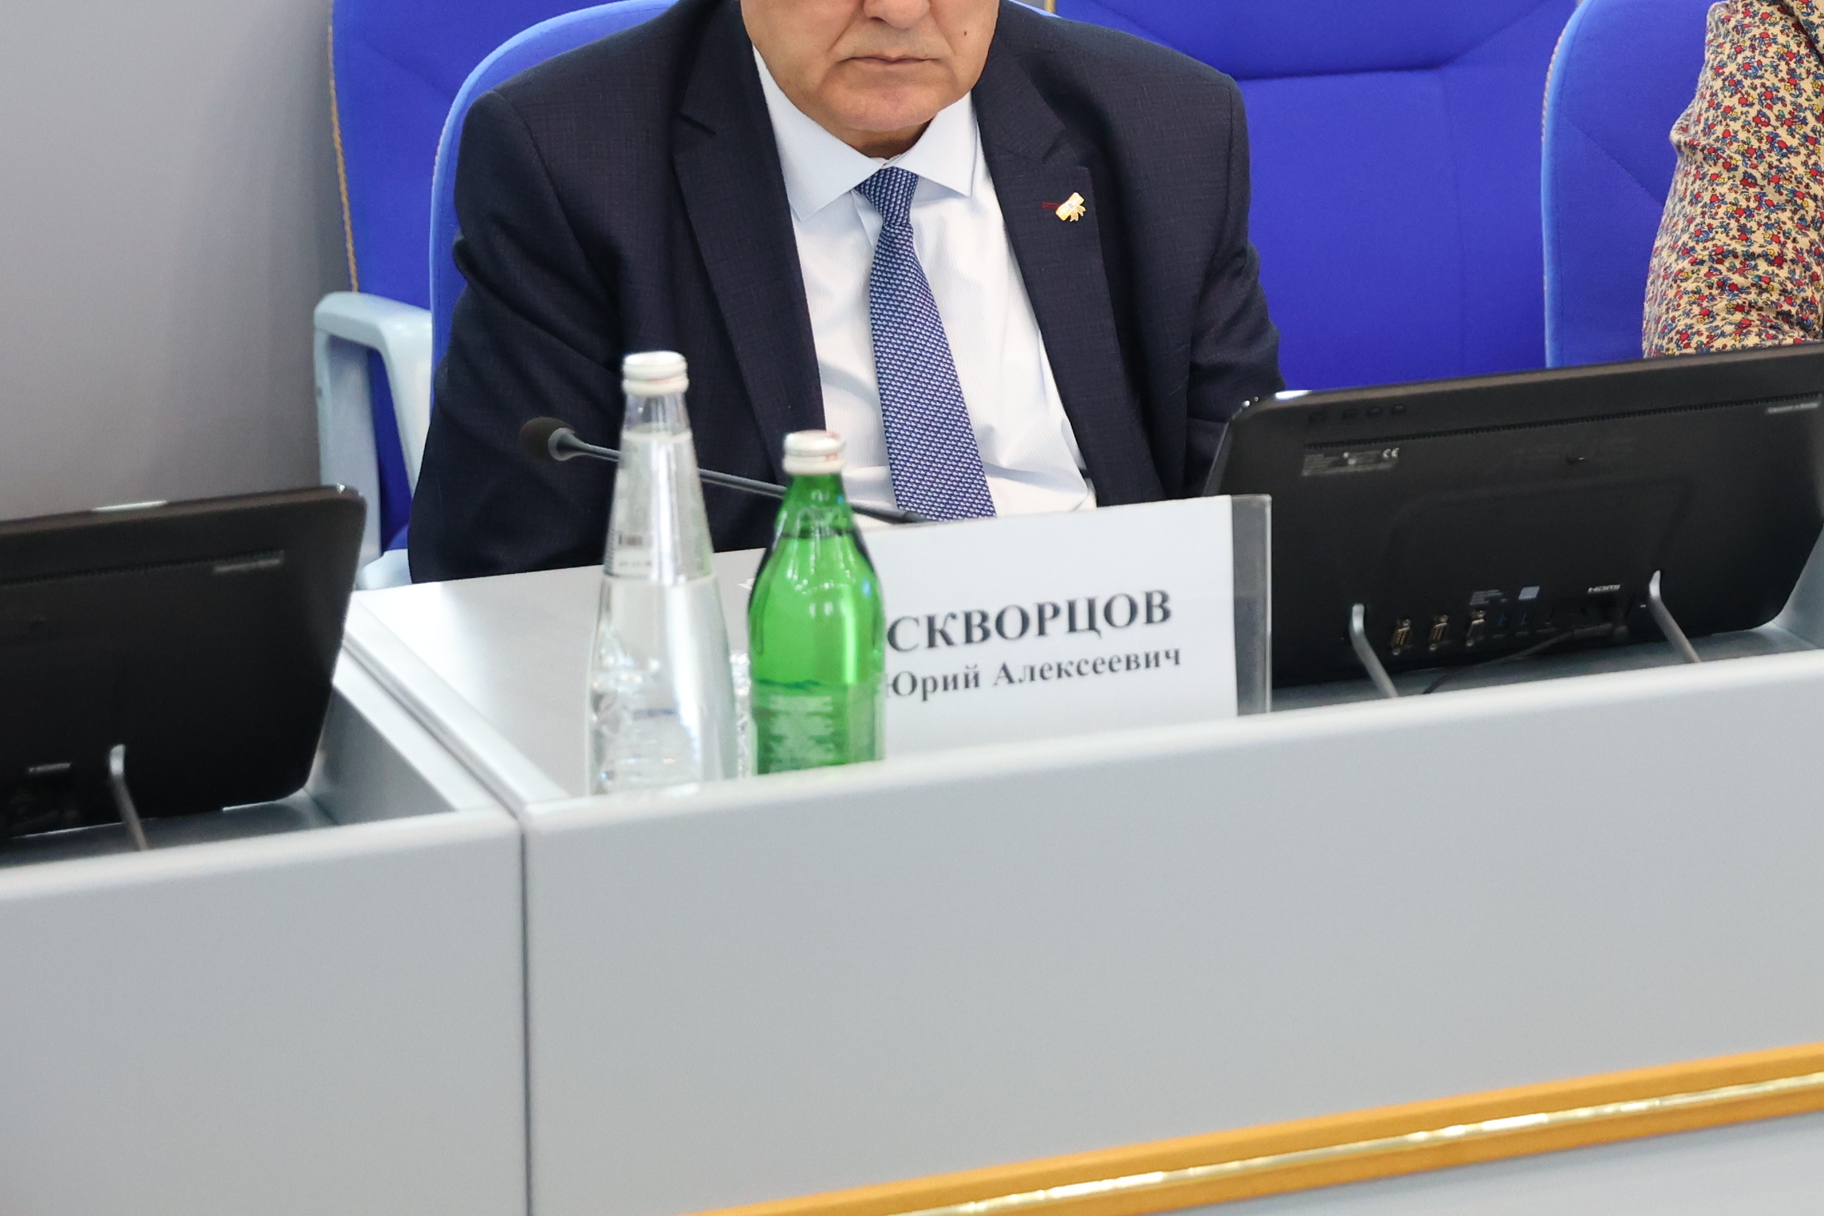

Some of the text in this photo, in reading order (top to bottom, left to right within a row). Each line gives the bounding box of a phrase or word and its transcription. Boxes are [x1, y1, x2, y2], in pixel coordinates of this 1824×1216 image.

[886, 589, 1173, 652] СКВОРЦОВ
[886, 648, 1182, 702] Юрий Алексеевич
